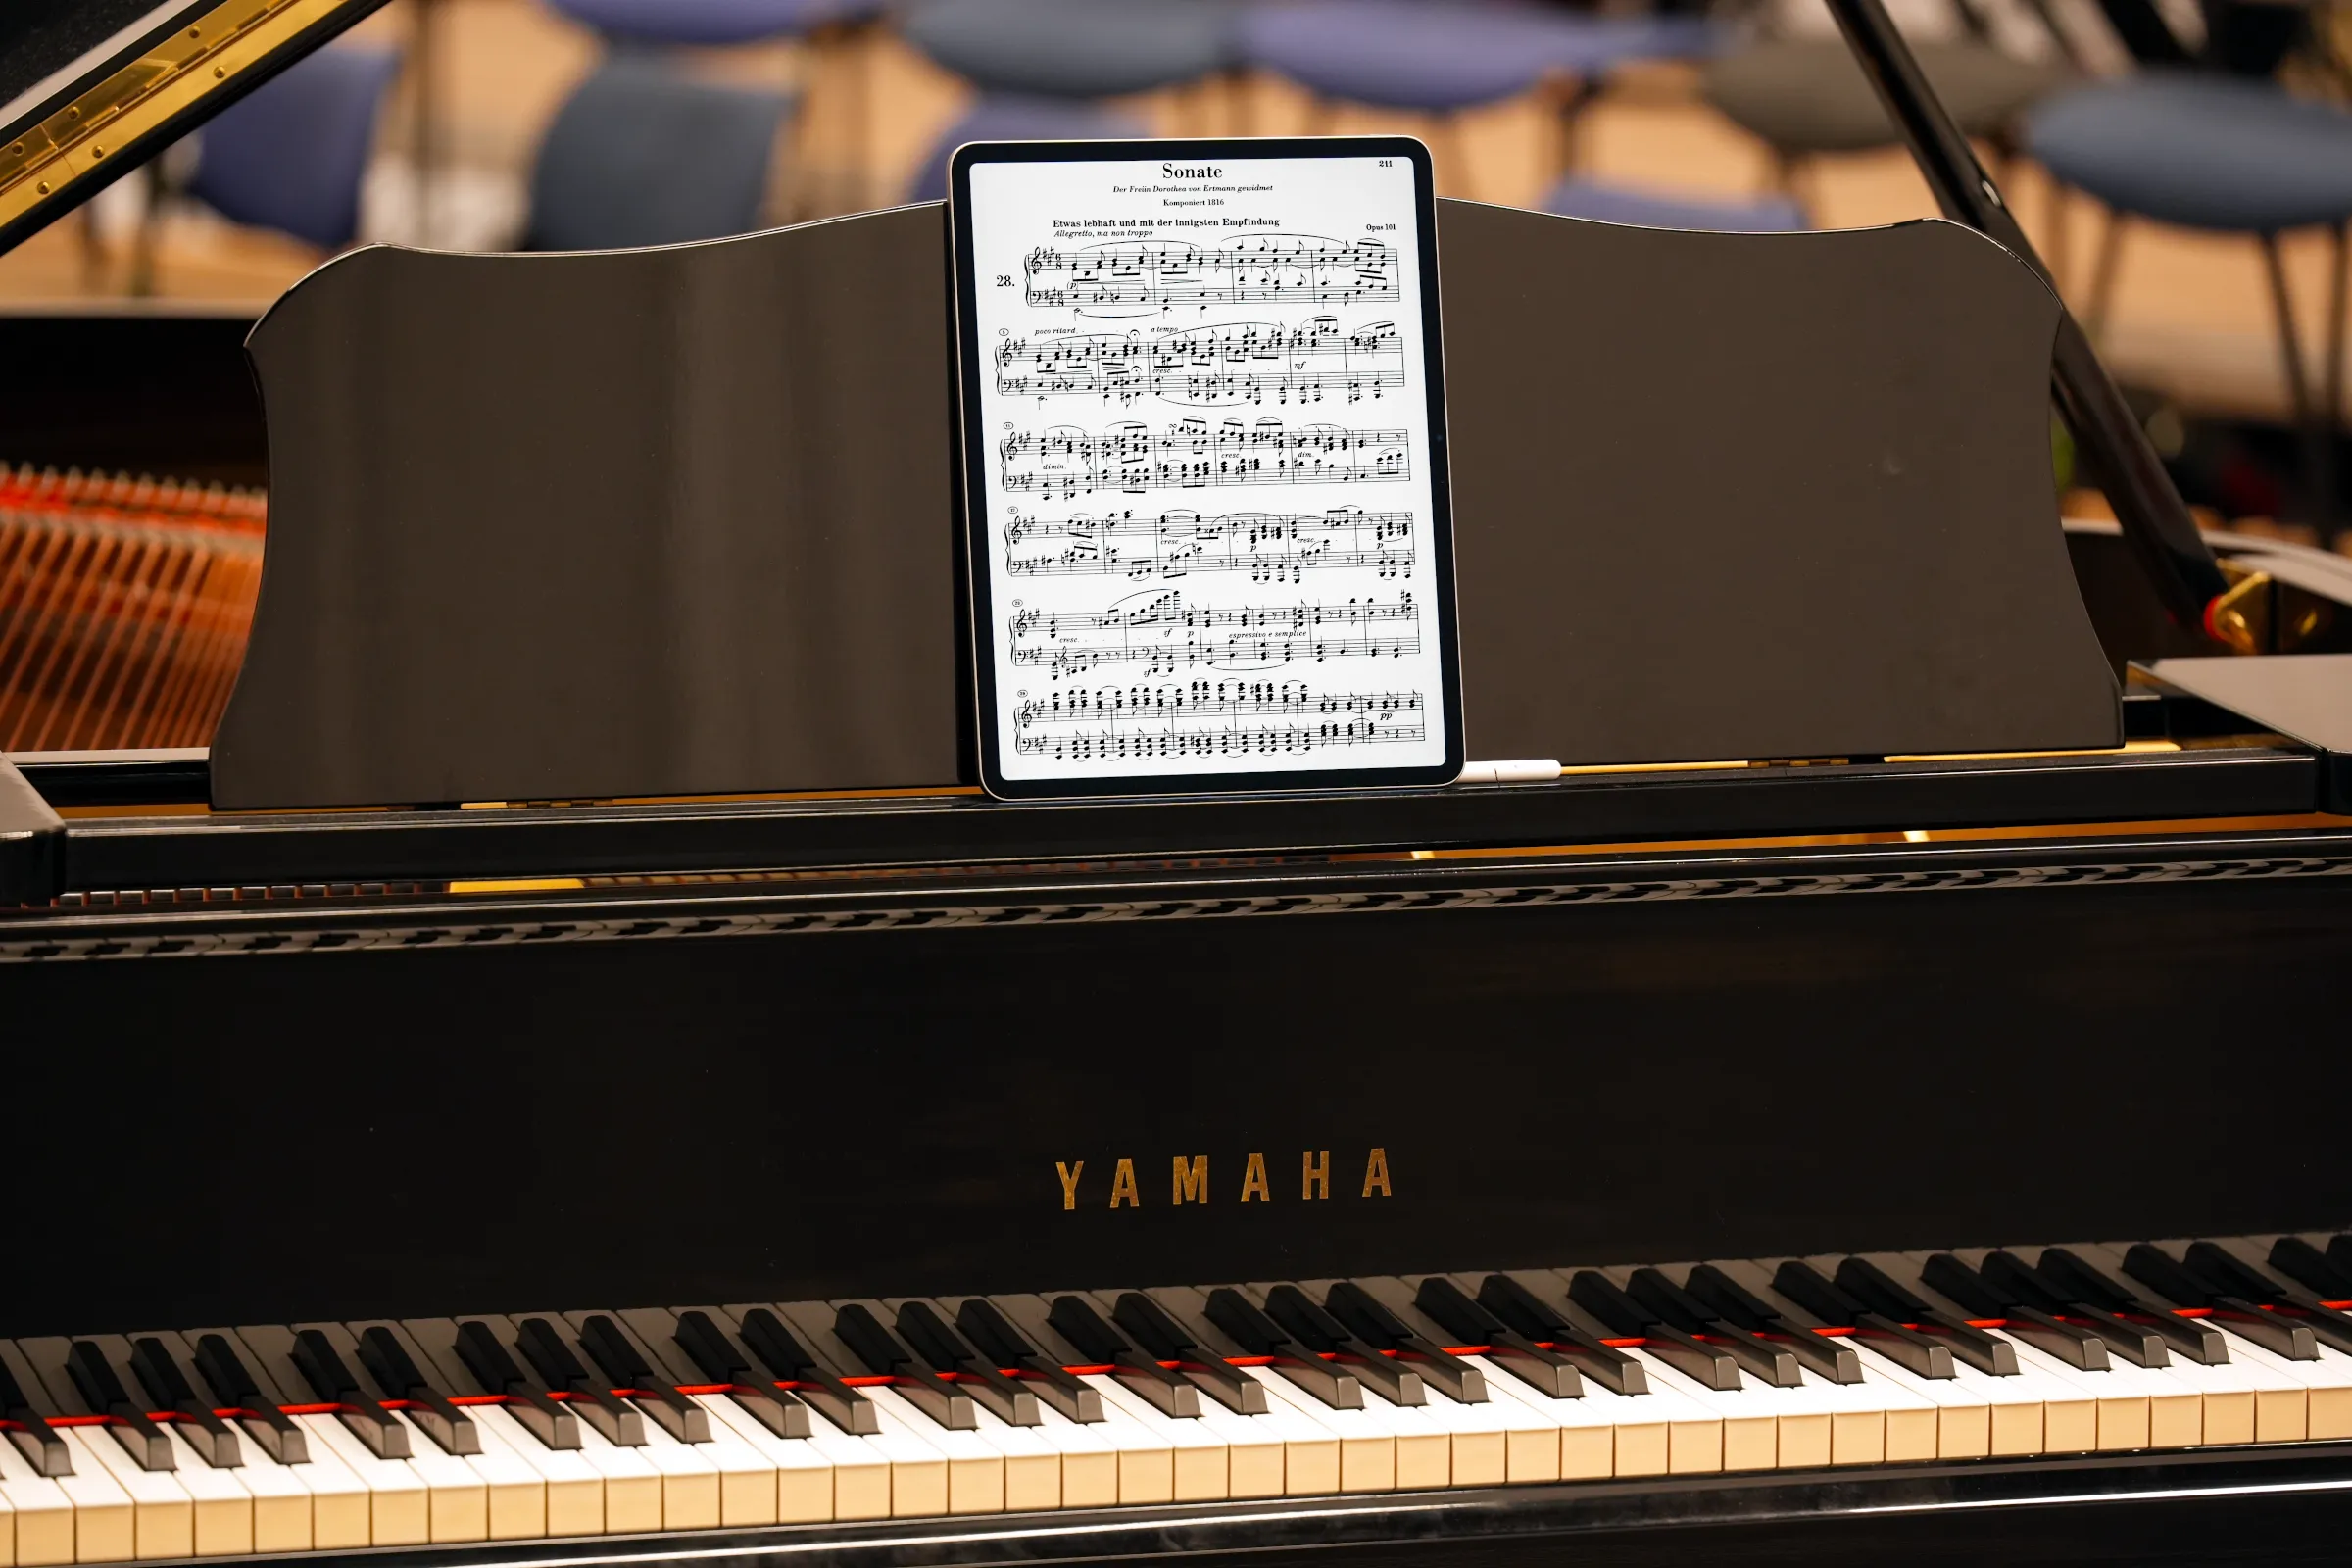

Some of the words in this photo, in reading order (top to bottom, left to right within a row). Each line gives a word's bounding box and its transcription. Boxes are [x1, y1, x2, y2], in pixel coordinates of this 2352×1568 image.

[1162, 163, 1223, 179] Sonate
[1237, 184, 1273, 193] gewidmet
[1176, 219, 1219, 227] innigsten
[1222, 218, 1280, 227] Empfindung
[1054, 230, 1095, 239] Allegretto,
[996, 275, 1015, 287] 28.
[1294, 361, 1306, 370] mf
[1055, 1147, 1392, 1211] YAMAHA
